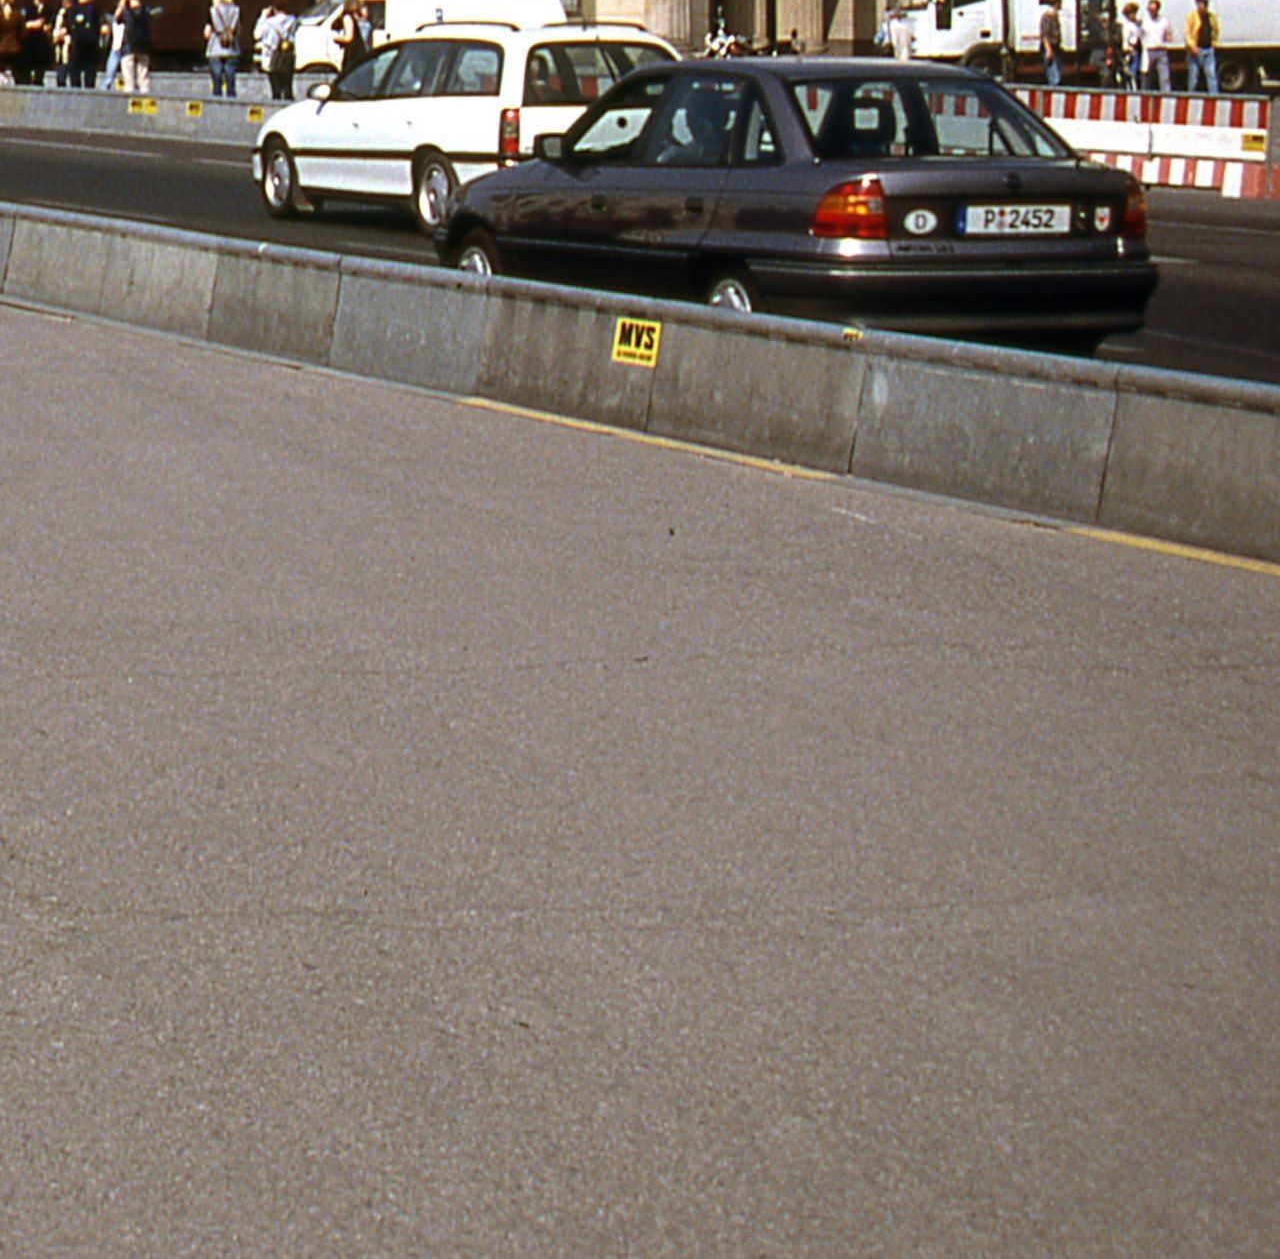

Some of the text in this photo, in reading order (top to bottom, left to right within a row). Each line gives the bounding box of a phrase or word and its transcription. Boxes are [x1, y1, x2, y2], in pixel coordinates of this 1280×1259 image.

[914, 213, 927, 230] D
[984, 209, 1056, 230] P 2452
[618, 321, 656, 351] MVS
